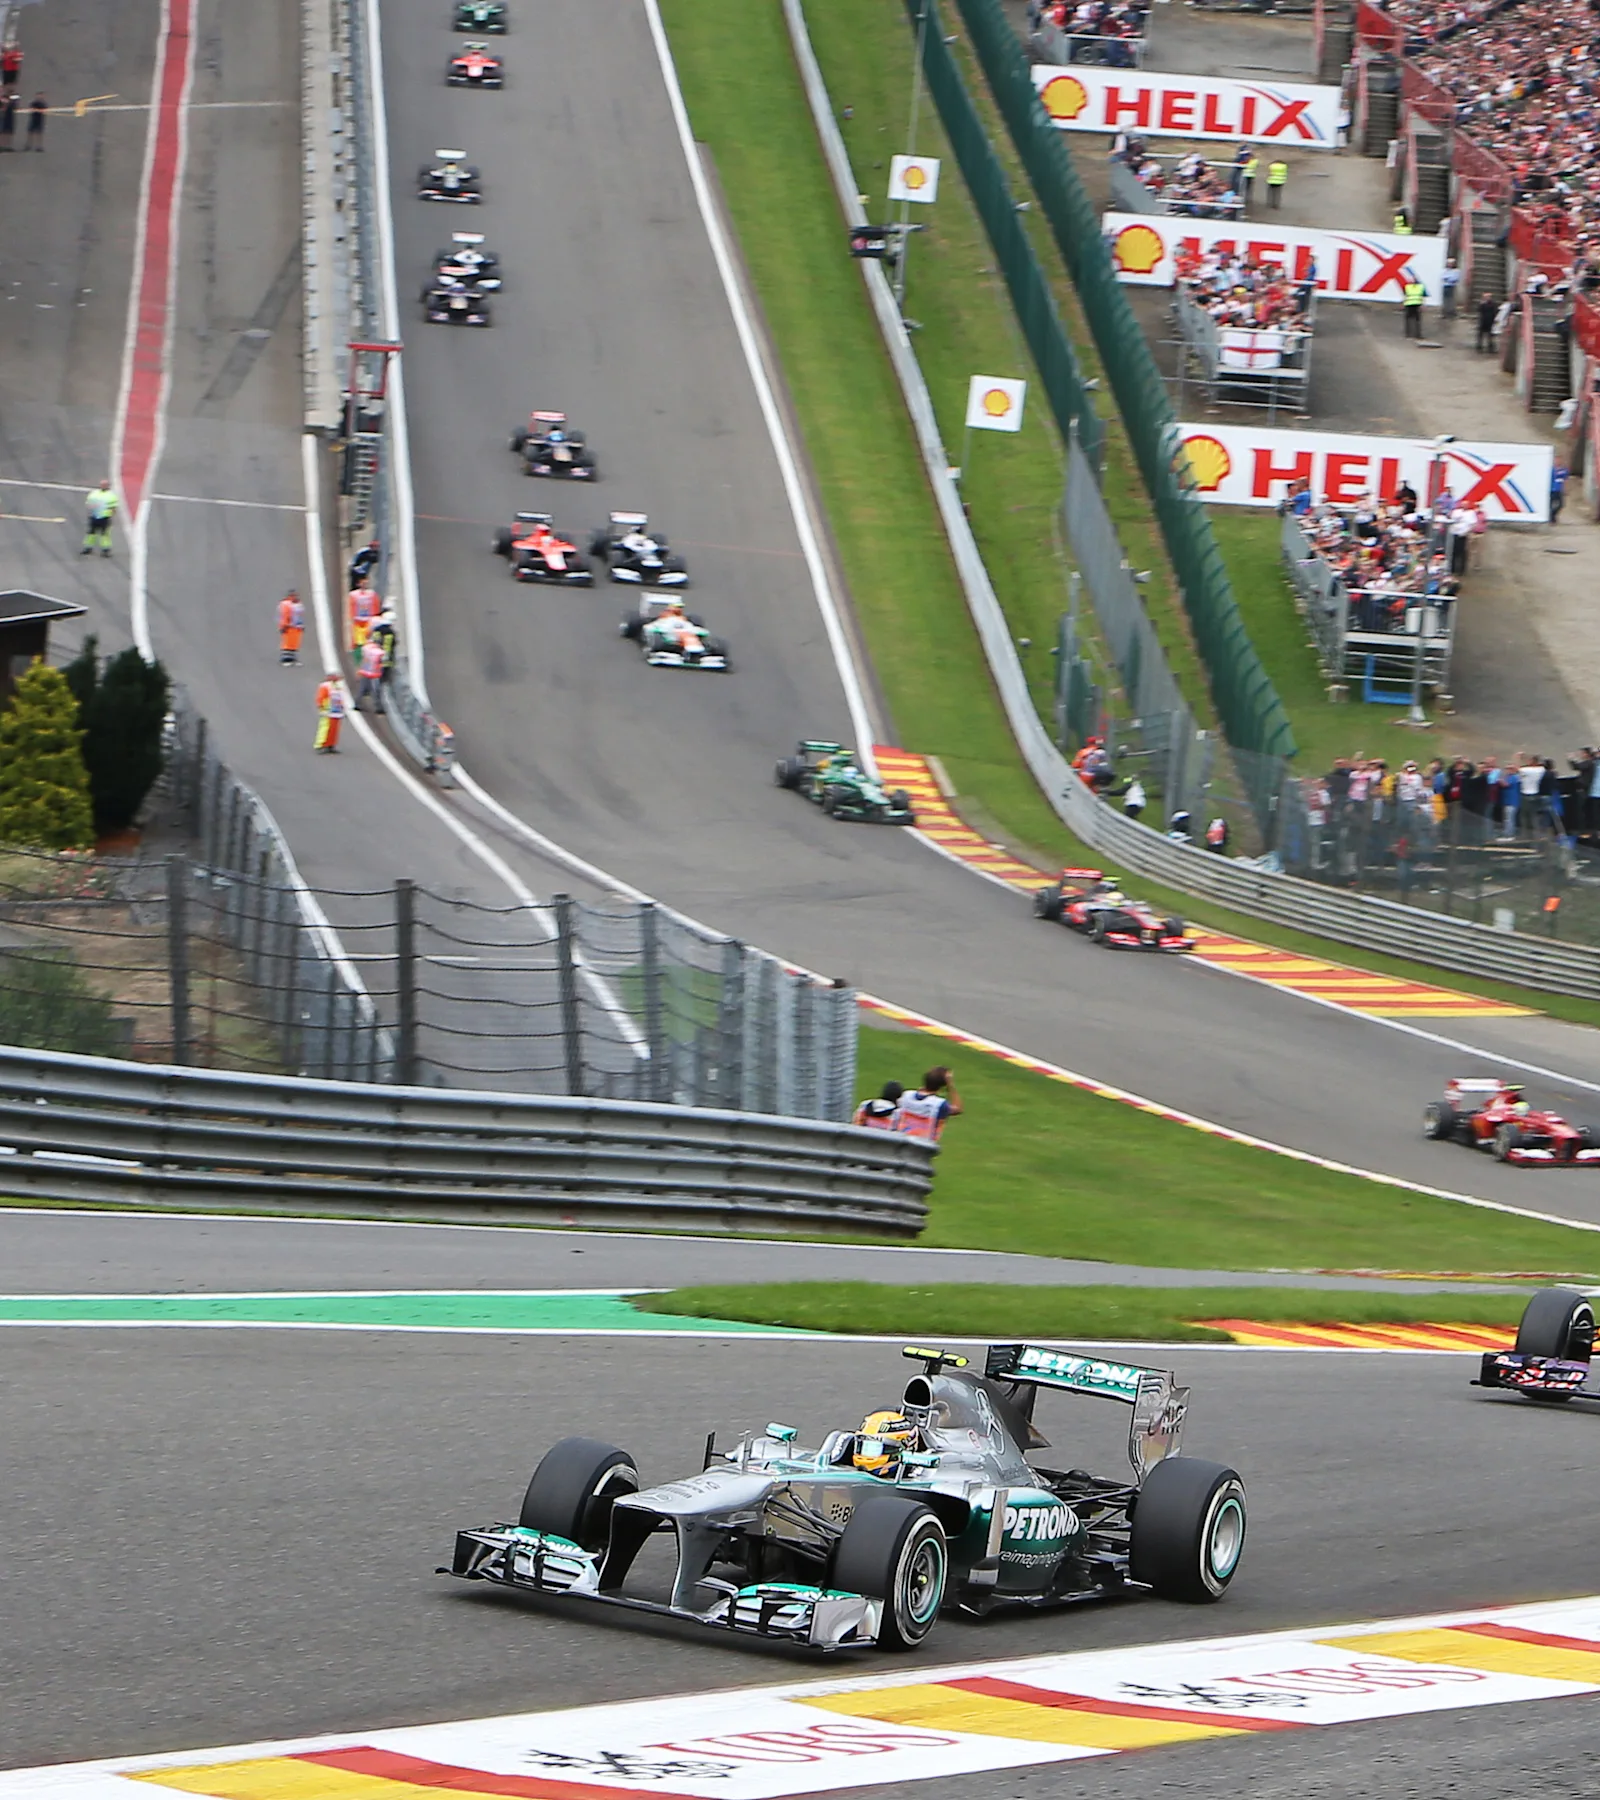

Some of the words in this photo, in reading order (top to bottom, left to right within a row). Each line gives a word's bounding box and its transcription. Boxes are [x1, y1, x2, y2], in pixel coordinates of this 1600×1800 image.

[1104, 84, 1314, 141] HELIX
[1251, 445, 1522, 513] HELIX
[1221, 1661, 1487, 1695] UBS
[641, 1723, 959, 1764] UBS
